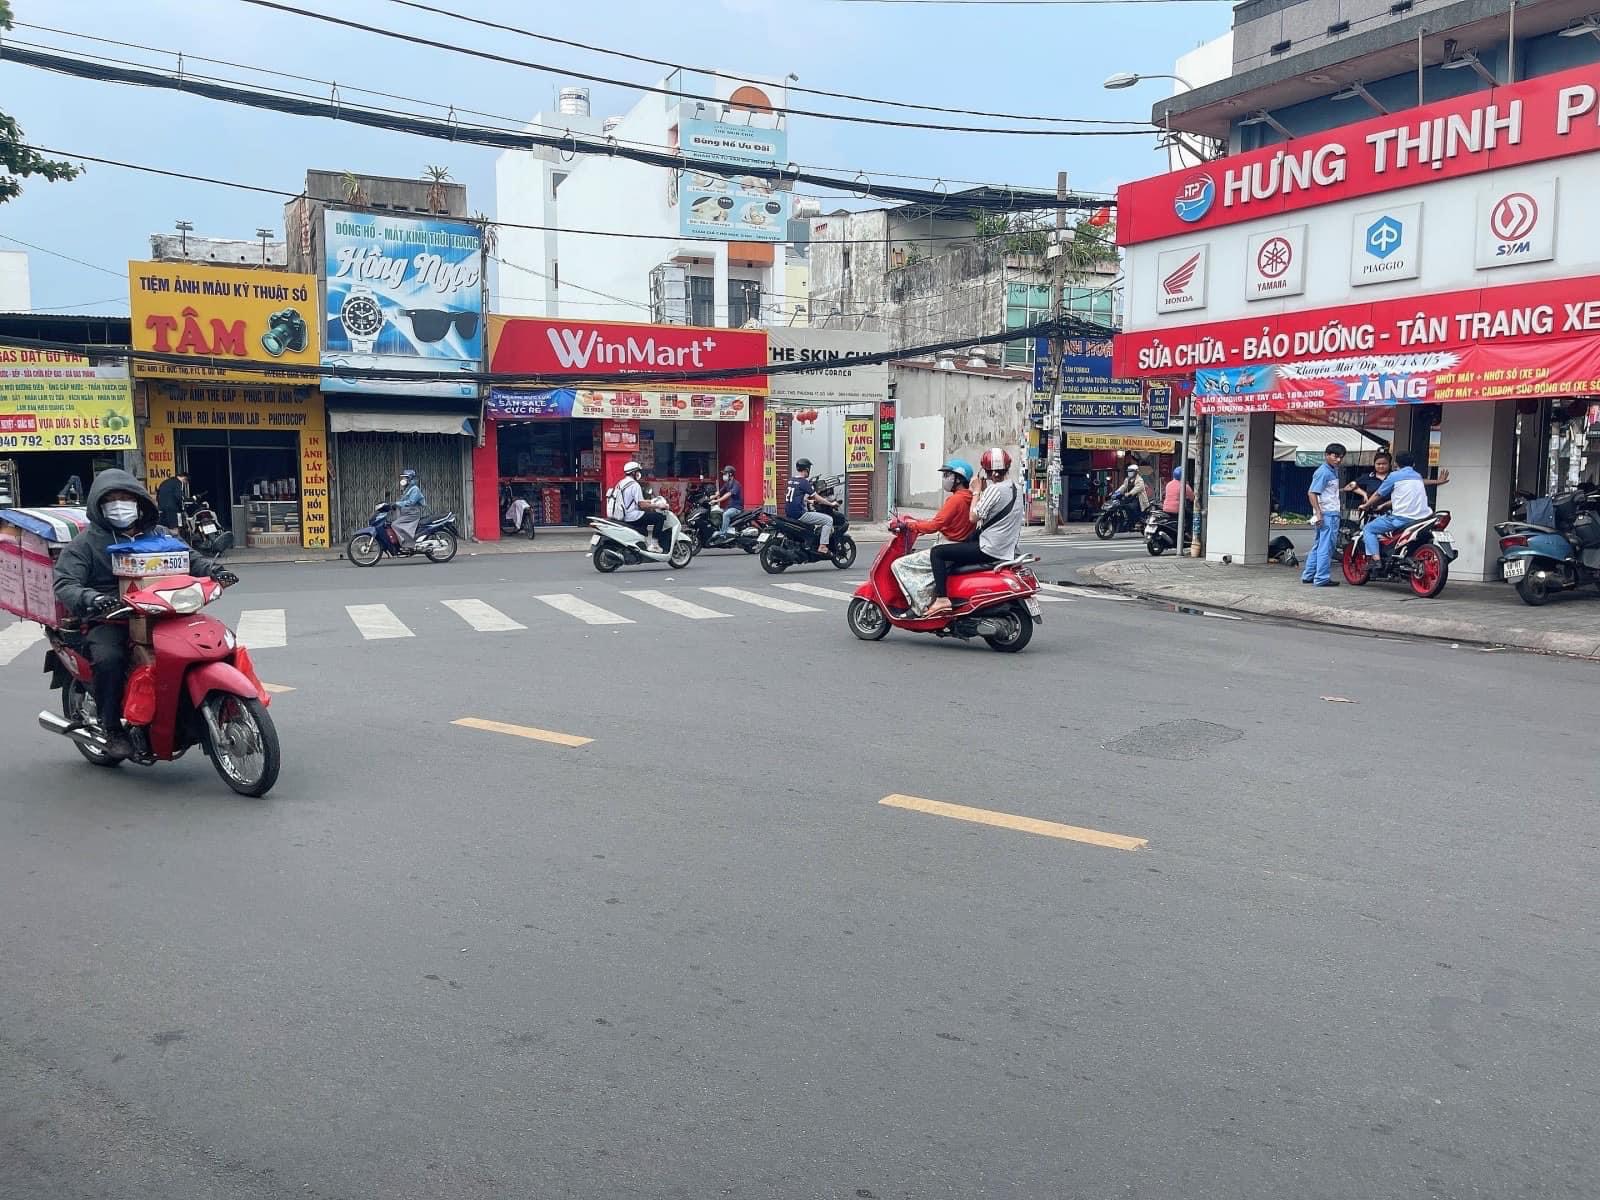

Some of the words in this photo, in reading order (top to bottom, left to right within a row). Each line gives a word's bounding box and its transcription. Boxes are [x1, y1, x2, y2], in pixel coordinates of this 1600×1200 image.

[1223, 143, 1347, 207] HƯNG
[1365, 100, 1523, 173] THỊNH
[1556, 84, 1600, 135] P
[452, 234, 480, 249] TRANG
[1496, 241, 1531, 256] SYM
[335, 244, 409, 289] Hồng
[414, 253, 480, 293] Ngọc
[1363, 261, 1404, 274] PIAGGIO
[140, 275, 170, 293] TIỆM
[174, 275, 200, 295] ẢNH
[203, 279, 230, 297] MÀU
[253, 284, 289, 303] THUẬT
[292, 283, 308, 302] SỐ
[1257, 280, 1287, 292] YAMAHA
[1165, 295, 1194, 305] HONDA
[146, 306, 249, 357] TÂM
[1138, 338, 1172, 369] SỬA
[1174, 336, 1226, 366] CHỮA
[1243, 327, 1290, 360] BẢO
[1293, 320, 1375, 356] DƯỠNG
[1396, 311, 1449, 346] TÂN
[1455, 305, 1554, 341] TRANG
[1562, 300, 1600, 332] XE
[768, 347, 795, 361] HE
[800, 348, 839, 362] SKIN
[1347, 376, 1428, 405] TẶNG
[1098, 404, 1119, 416] DECAL
[268, 412, 307, 426] PHOTOCOPY
[21, 435, 43, 447] 792
[54, 435, 75, 446] 037
[79, 434, 101, 446] 353
[304, 489, 327, 499] PHỤC
[169, 557, 182, 569] 502
